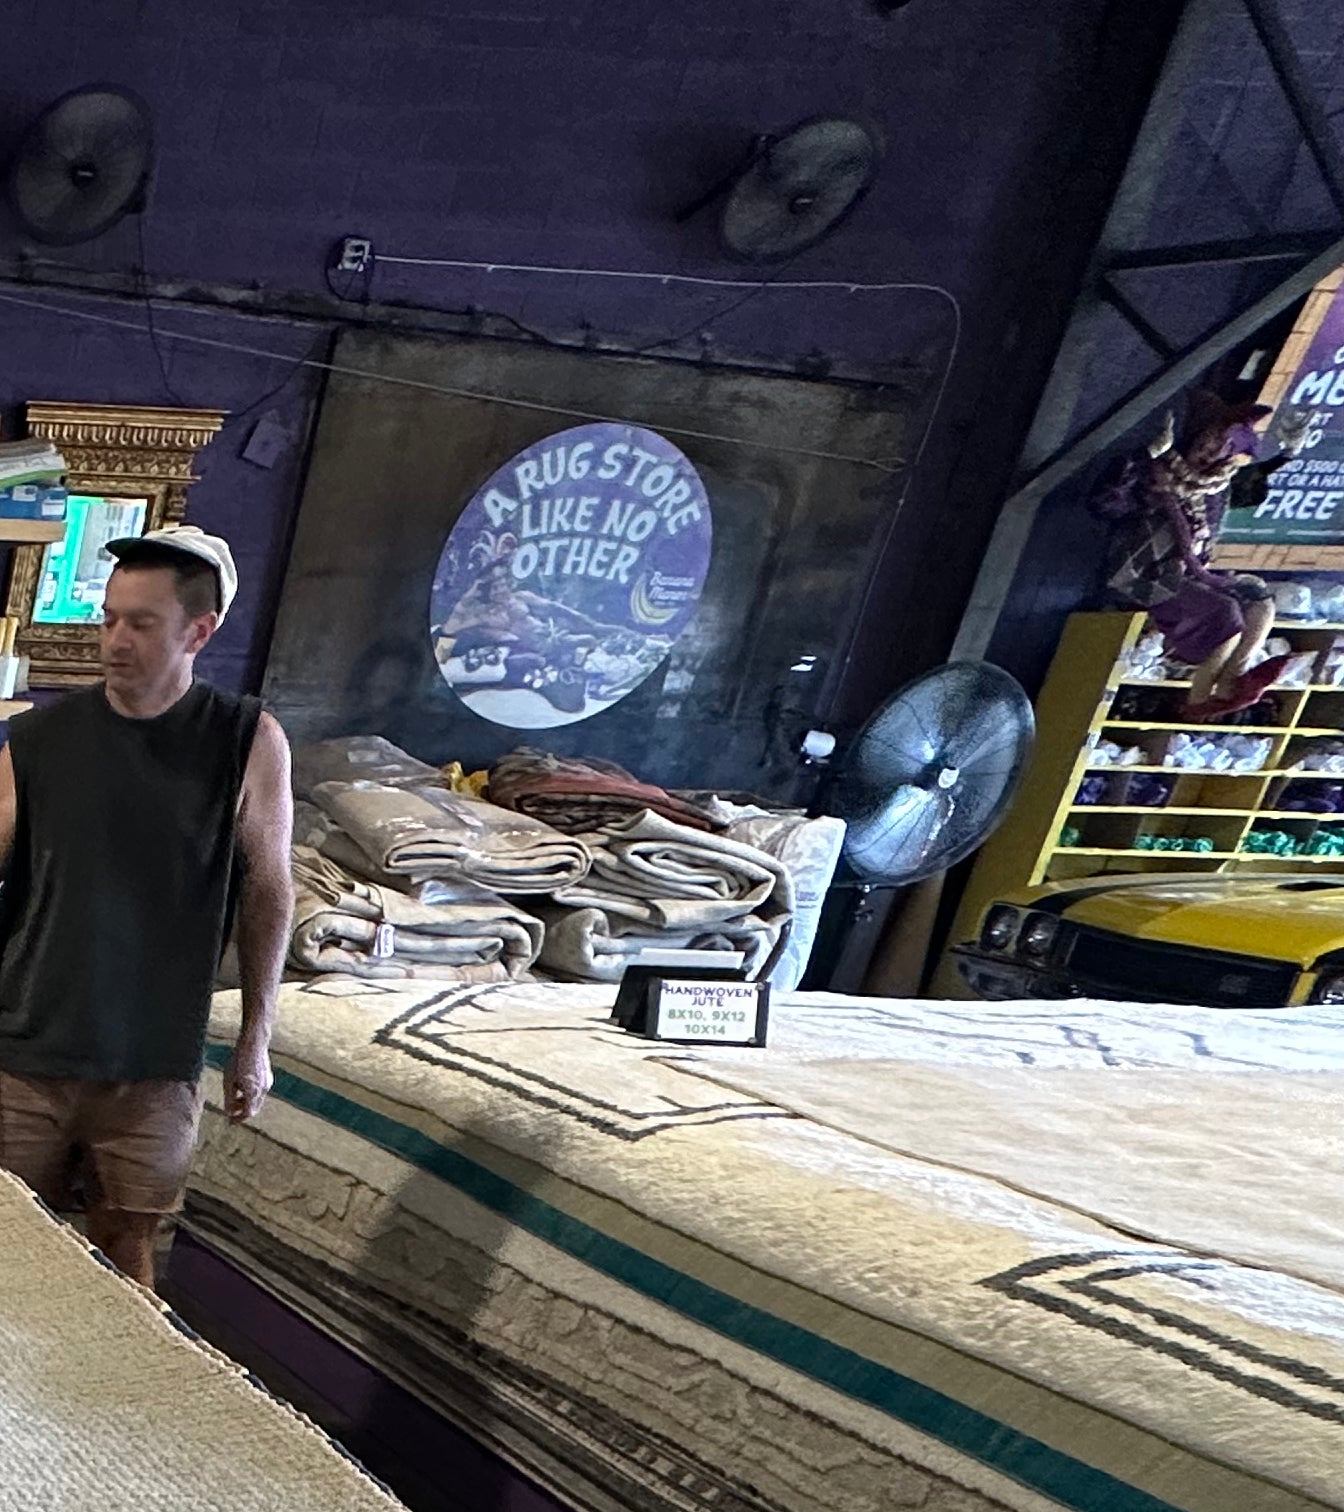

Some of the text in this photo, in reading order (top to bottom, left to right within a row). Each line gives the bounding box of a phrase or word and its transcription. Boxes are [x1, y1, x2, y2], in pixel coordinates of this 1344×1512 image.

[483, 442, 702, 535] A RUG STORE
[1253, 489, 1344, 520] FREE
[521, 497, 657, 542] LIKE NO
[512, 537, 640, 584] OTHER
[665, 986, 753, 997] HANDWOVEN
[692, 997, 724, 1007] JUTE
[711, 1010, 746, 1023] 9X12
[685, 1024, 726, 1035] 10X14
